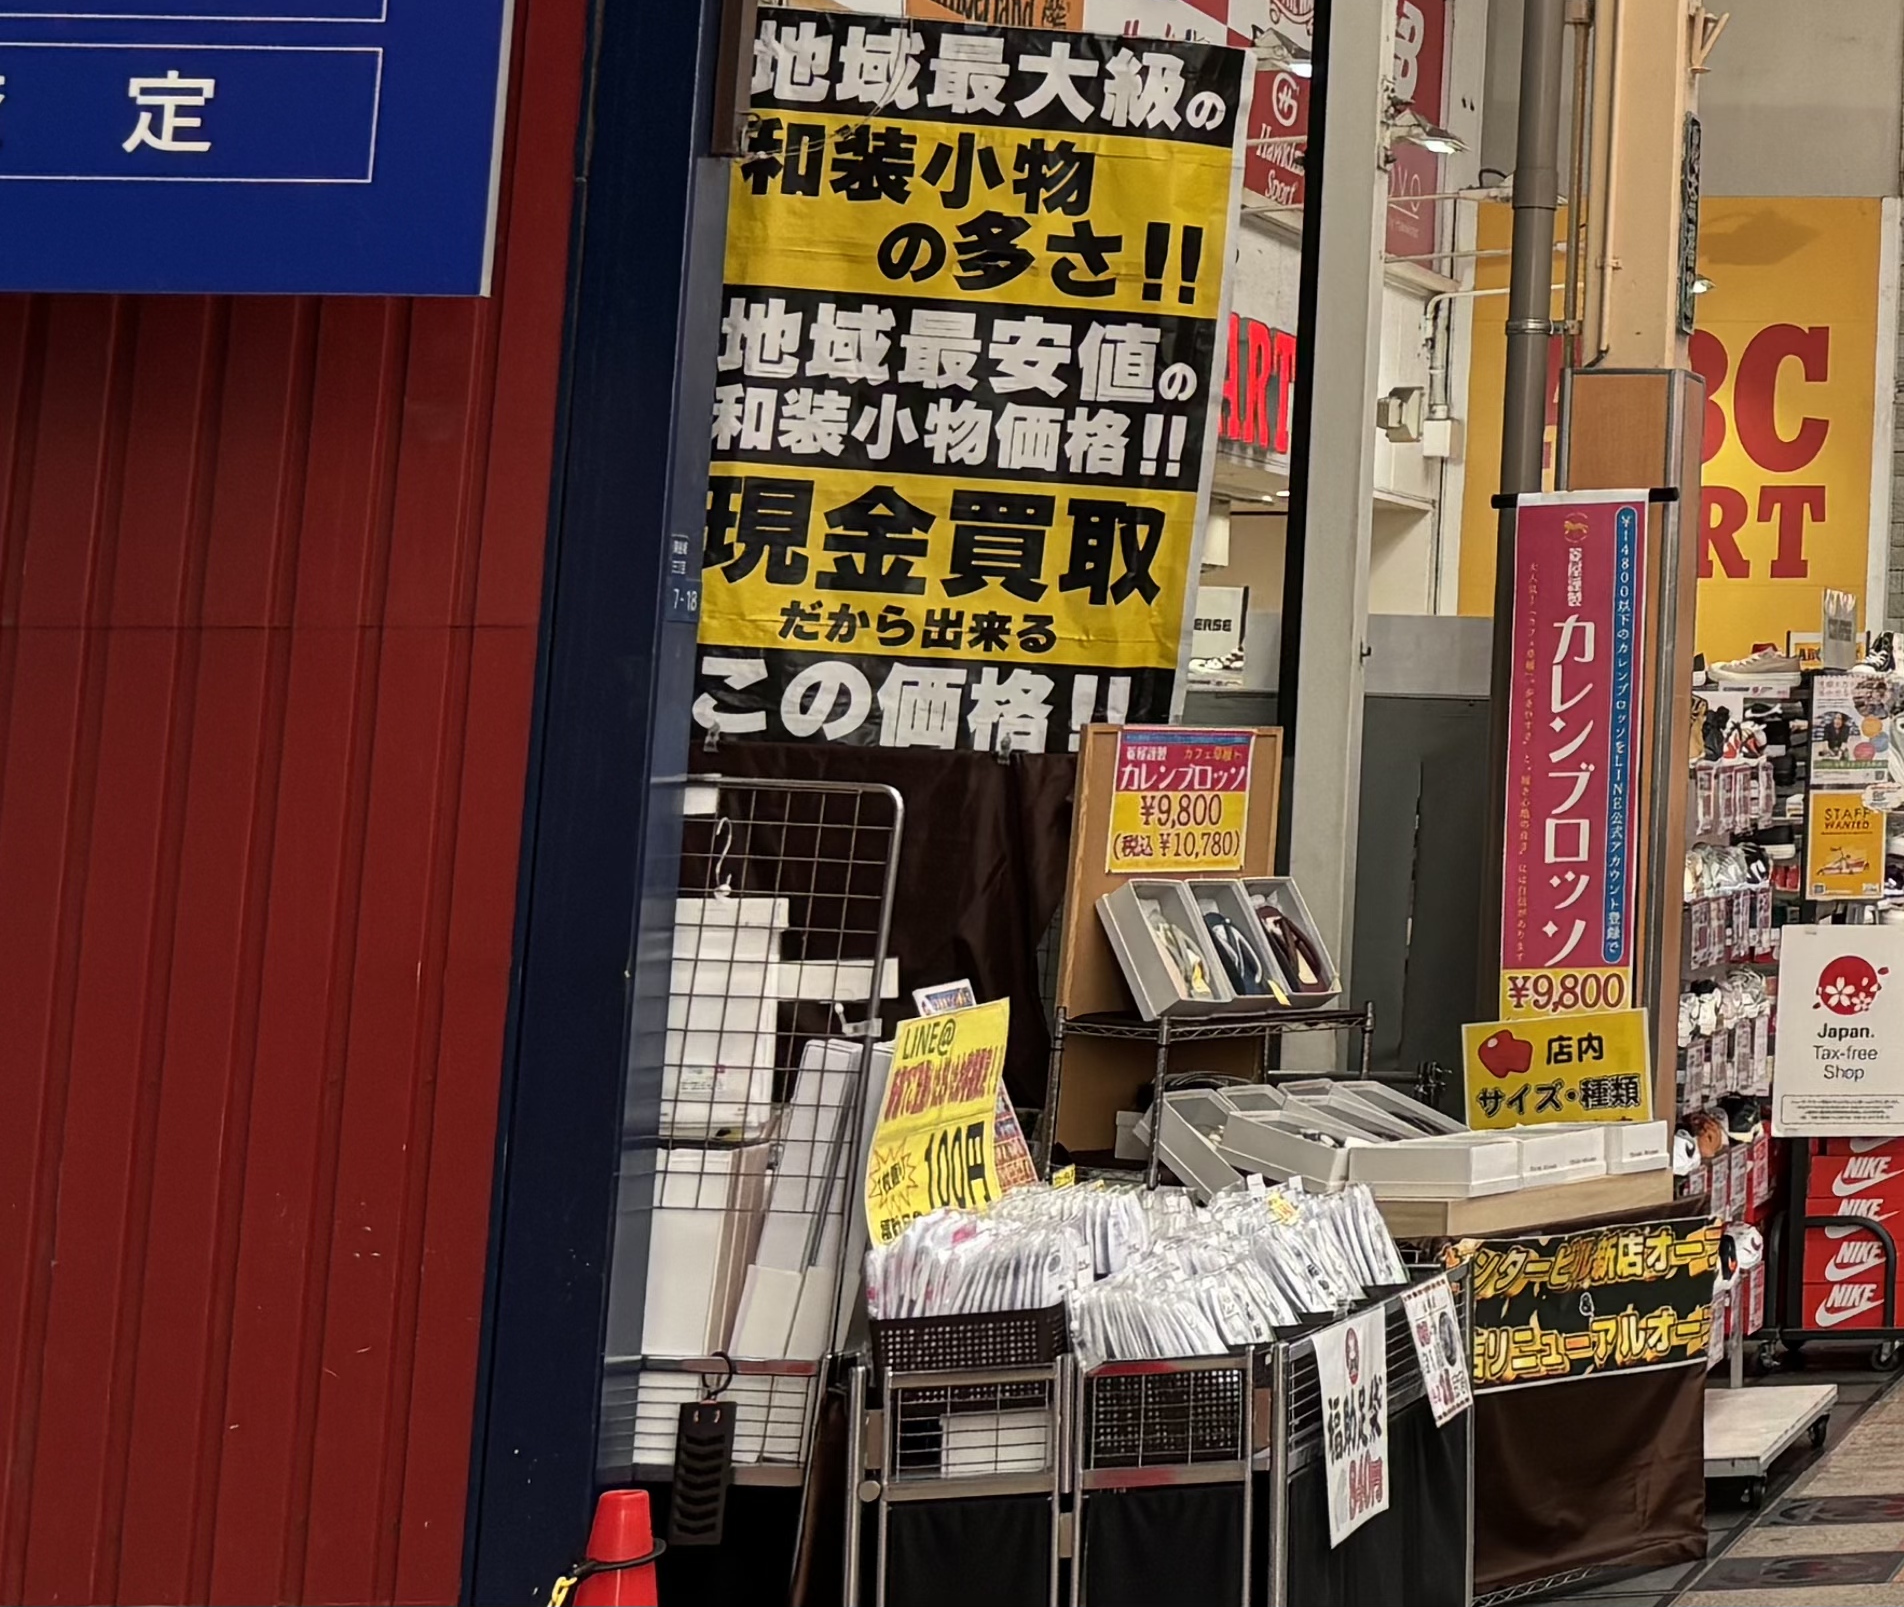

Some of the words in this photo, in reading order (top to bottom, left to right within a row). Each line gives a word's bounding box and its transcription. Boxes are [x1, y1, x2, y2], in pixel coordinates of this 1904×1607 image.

[749, 20, 1226, 132] 地域最大級の
[740, 121, 1096, 217] 和装小物
[877, 215, 1204, 305] の多さ!!
[714, 297, 1198, 404] 地域最安値の
[710, 386, 1188, 478] 和装小物価格!!
[701, 476, 1169, 607] 現金買取
[778, 601, 1058, 653] だから出来る
[692, 655, 1132, 755] この価格!!
[1119, 763, 1247, 791] カレンブロッソ
[1542, 613, 1597, 967] カレンブロッソ
[1140, 793, 1223, 830] ¥9,800
[1507, 971, 1626, 1013] ¥9,800
[901, 1017, 957, 1061] LINE@
[1546, 1033, 1605, 1066] 店内
[1816, 1022, 1876, 1041] Japan.
[1812, 1045, 1879, 1062] Tax-free
[1822, 1065, 1866, 1082] Shop
[1476, 1073, 1643, 1120] サイズ・種類
[1842, 1155, 1893, 1179] NIKE
[1837, 1198, 1886, 1219] NIKE
[1834, 1241, 1885, 1264] NIKE
[1825, 1283, 1878, 1308] NIKE
